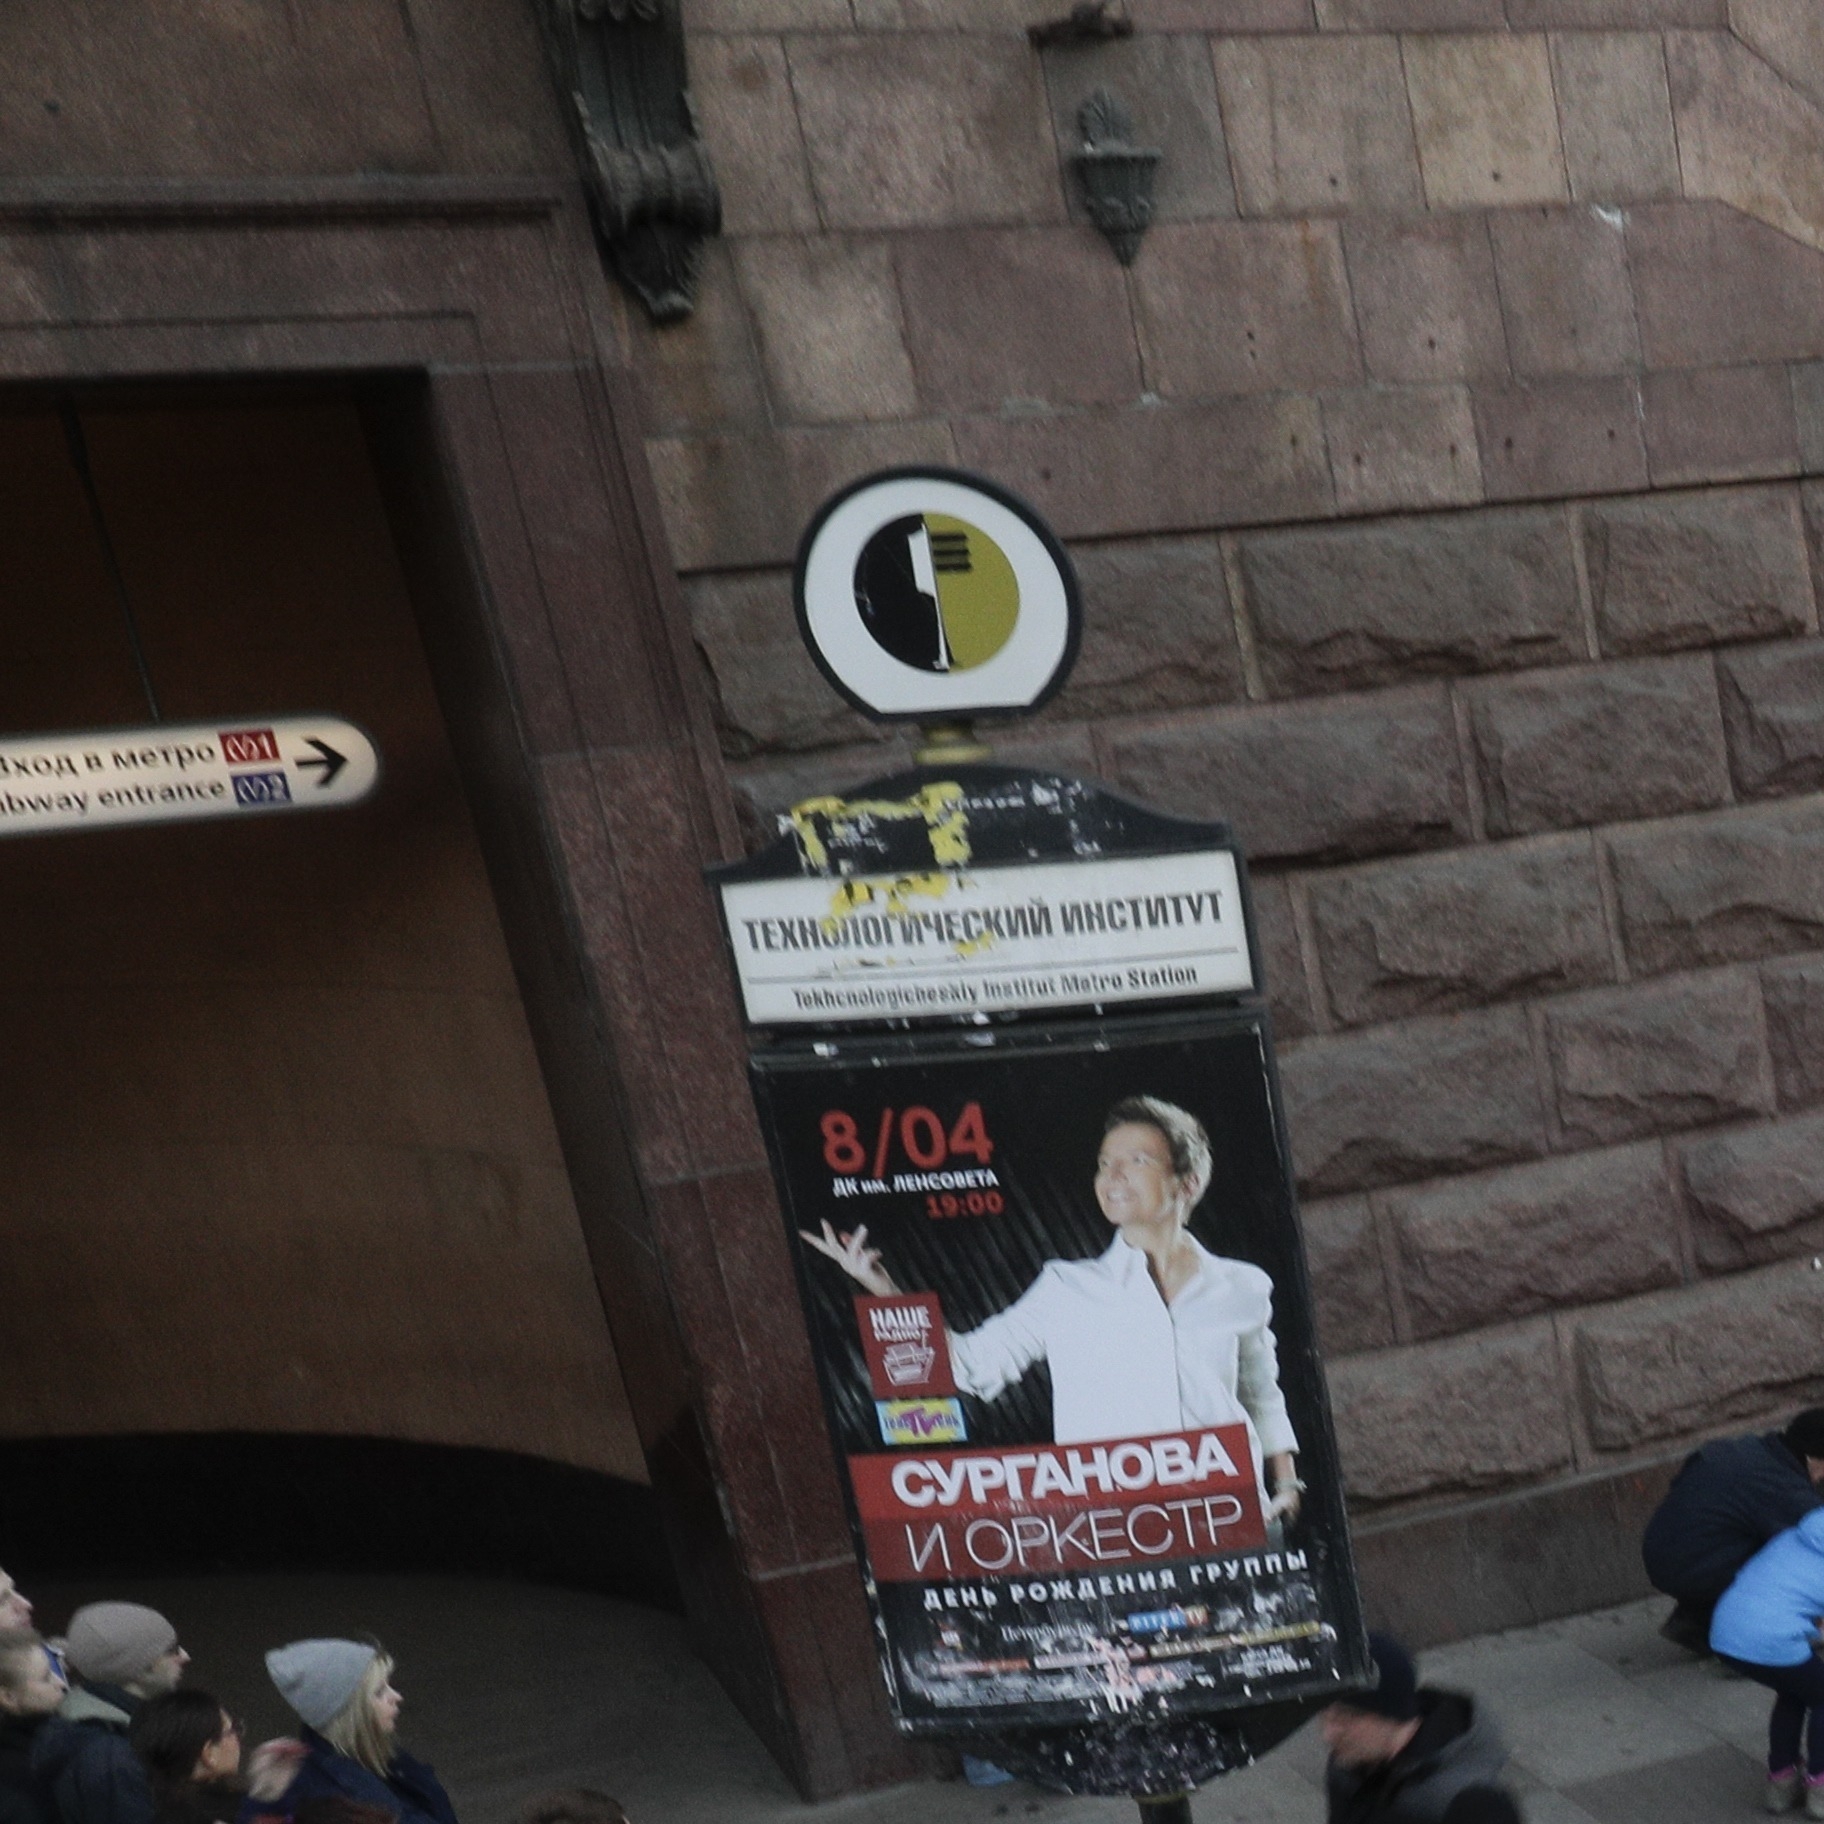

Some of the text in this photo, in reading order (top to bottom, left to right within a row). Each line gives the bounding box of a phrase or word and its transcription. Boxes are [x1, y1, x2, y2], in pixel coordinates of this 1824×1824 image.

[111, 743, 216, 771] метро
[99, 780, 226, 808] entrance
[741, 890, 1222, 951] ТЕХНОЛОГИЧЕСКИЙ ИНСТИТУТ
[983, 974, 1056, 1000] Institut
[1060, 971, 1122, 994] Metro
[1127, 965, 1198, 988] Station
[820, 1101, 994, 1179] 8/04
[832, 1177, 860, 1199] ДК
[893, 1167, 1000, 1193] ЛЕНСОВЕТА
[926, 1189, 1005, 1220] 19:00
[868, 1306, 933, 1332] НАШЕ
[890, 1432, 1240, 1508] СУРГАНОВА
[904, 1493, 1244, 1574] И ОРКЕСТР
[923, 1548, 1308, 1612] ДЕНЬ РОЖДЕНИЯ ГРУППЫ
